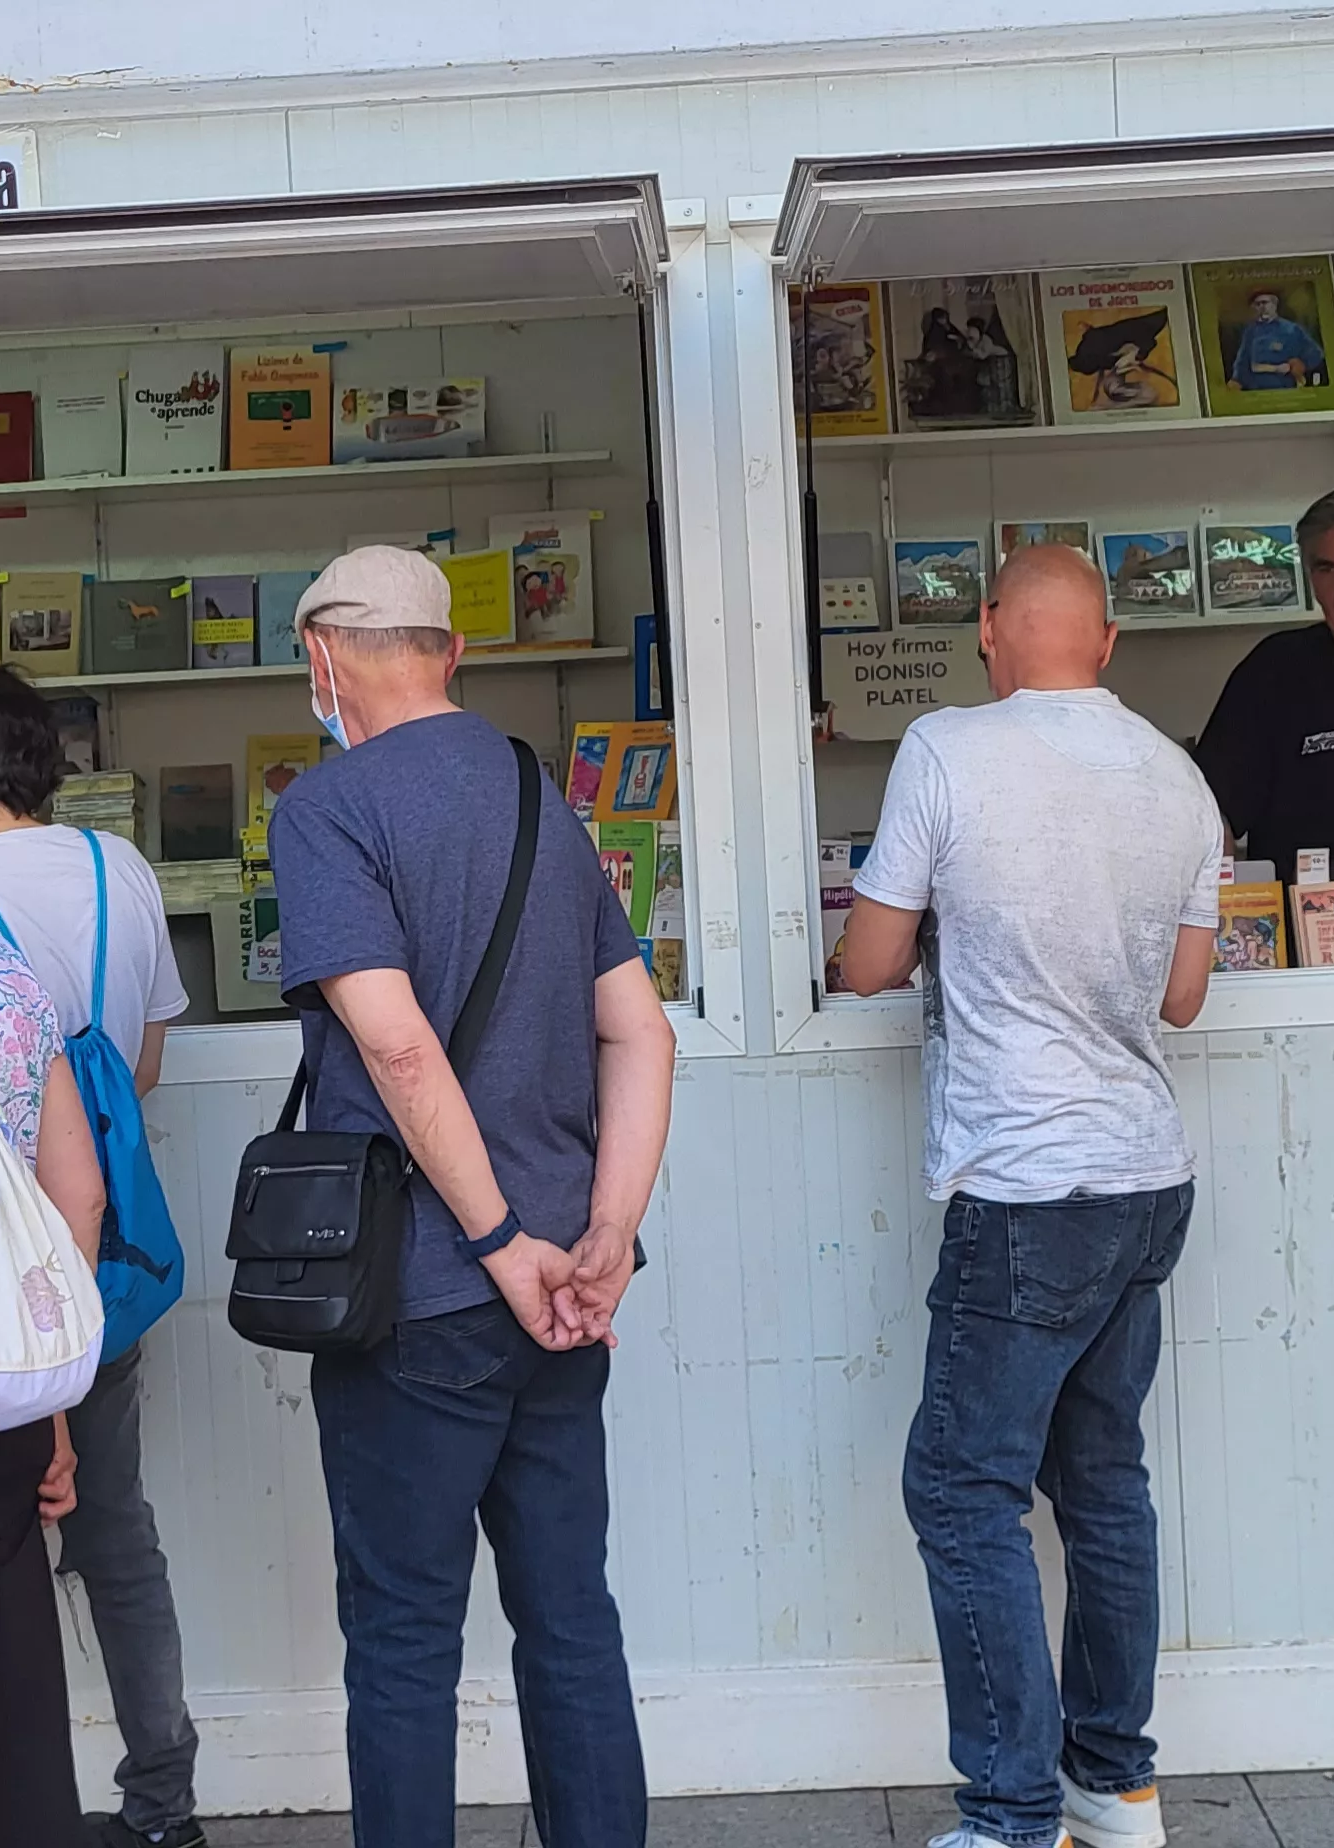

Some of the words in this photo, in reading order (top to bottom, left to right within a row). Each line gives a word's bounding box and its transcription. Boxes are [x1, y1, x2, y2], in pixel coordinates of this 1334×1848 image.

[157, 402, 215, 422] aprende
[847, 641, 886, 660] Hoy
[891, 638, 954, 655] firma:
[855, 662, 948, 682] DIONISIO
[866, 687, 939, 707] PLATEL
